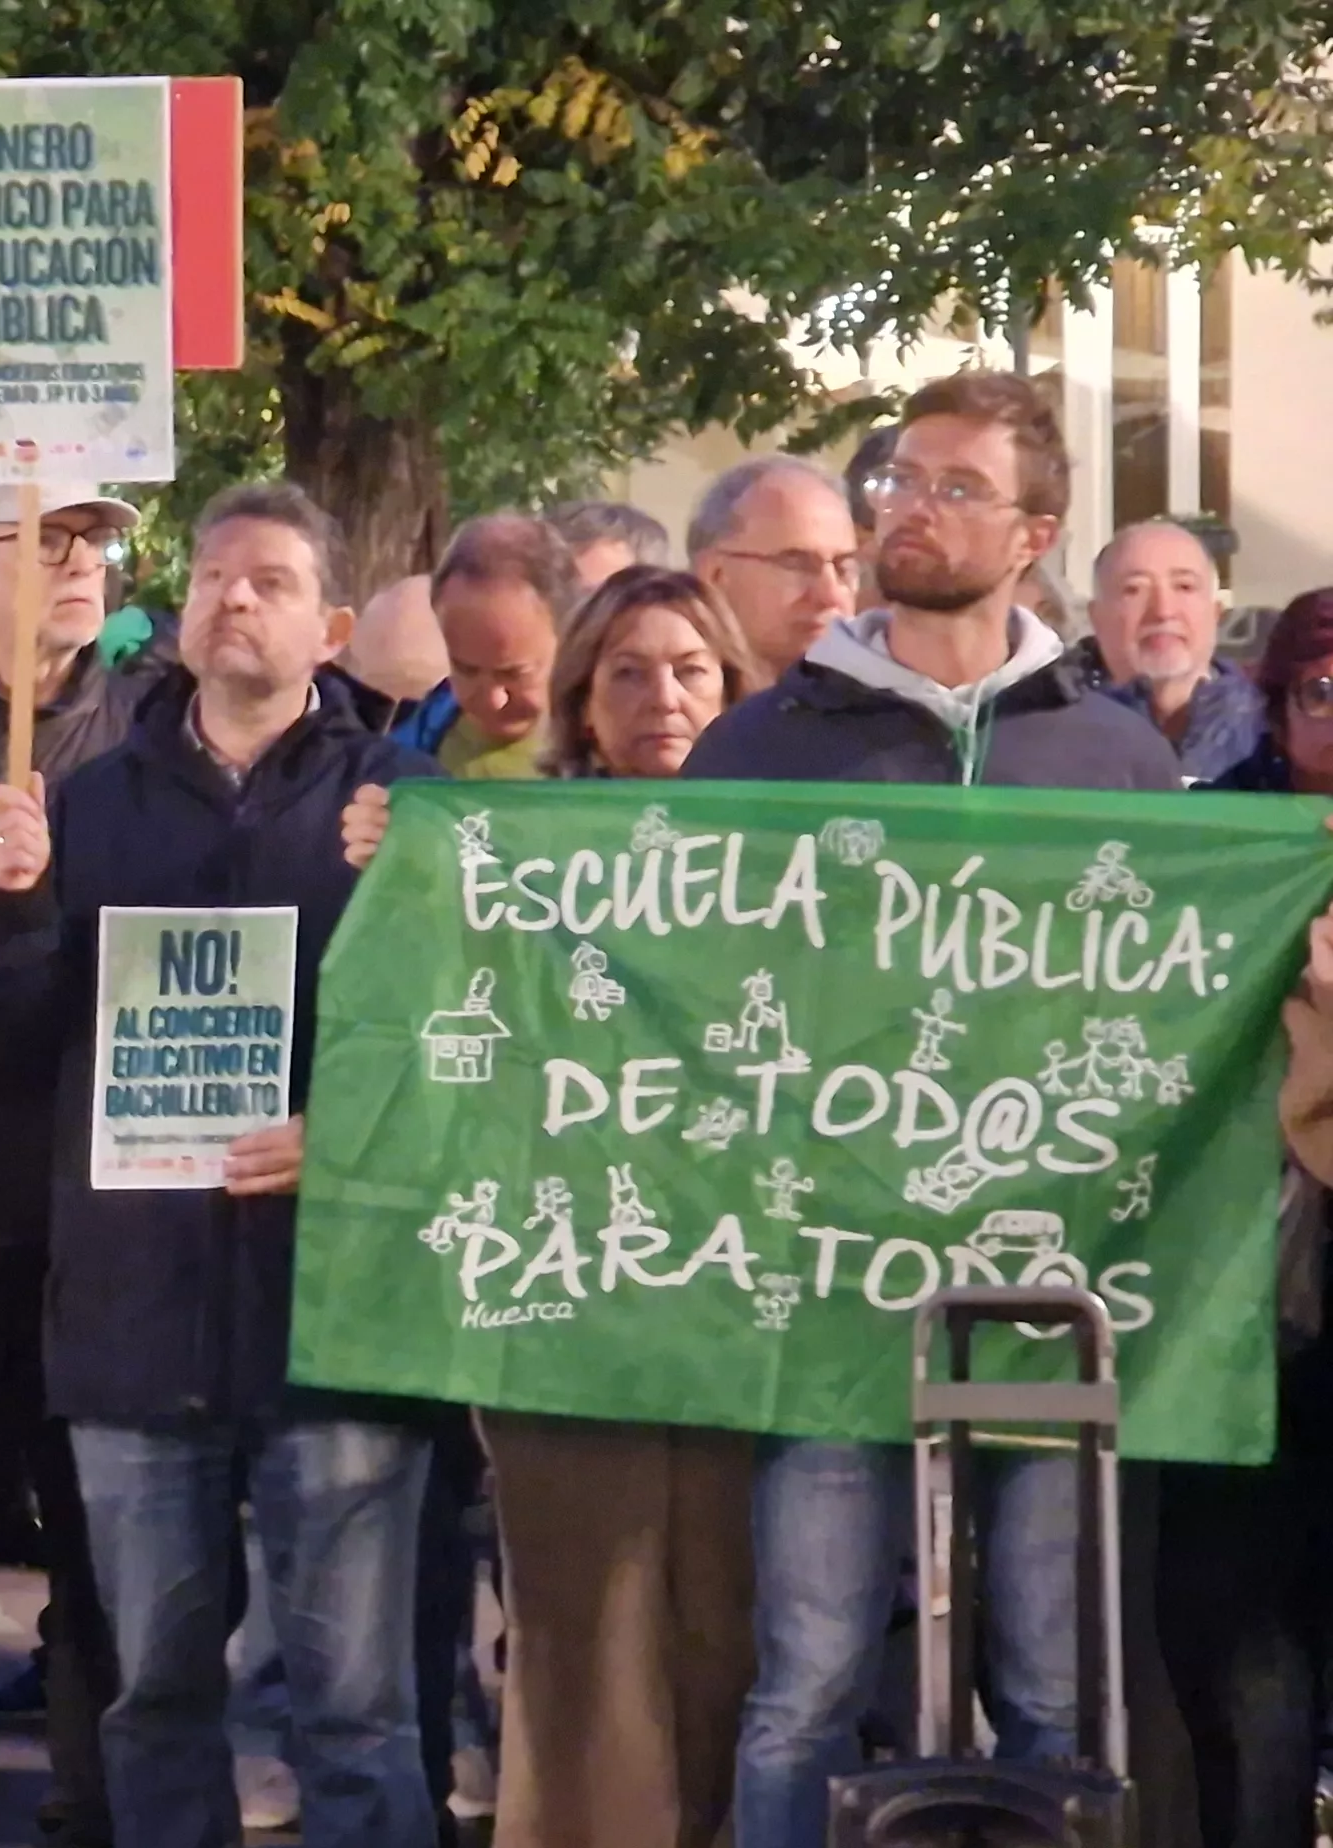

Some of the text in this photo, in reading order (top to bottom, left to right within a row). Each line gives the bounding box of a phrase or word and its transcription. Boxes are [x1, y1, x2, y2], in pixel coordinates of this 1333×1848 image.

[62, 179, 156, 228] PARA
[460, 832, 1234, 997] ESCUELA PÚBLICA:
[159, 929, 241, 996] NO!
[114, 1005, 282, 1038] AL CONCIERTO
[113, 1044, 281, 1078] EDUCATIVO EN
[105, 1082, 280, 1117] BACHILLERATO
[542, 1056, 1120, 1177] DE TOD@S
[454, 1213, 760, 1300] PARA
[461, 1301, 577, 1329] Huesca
